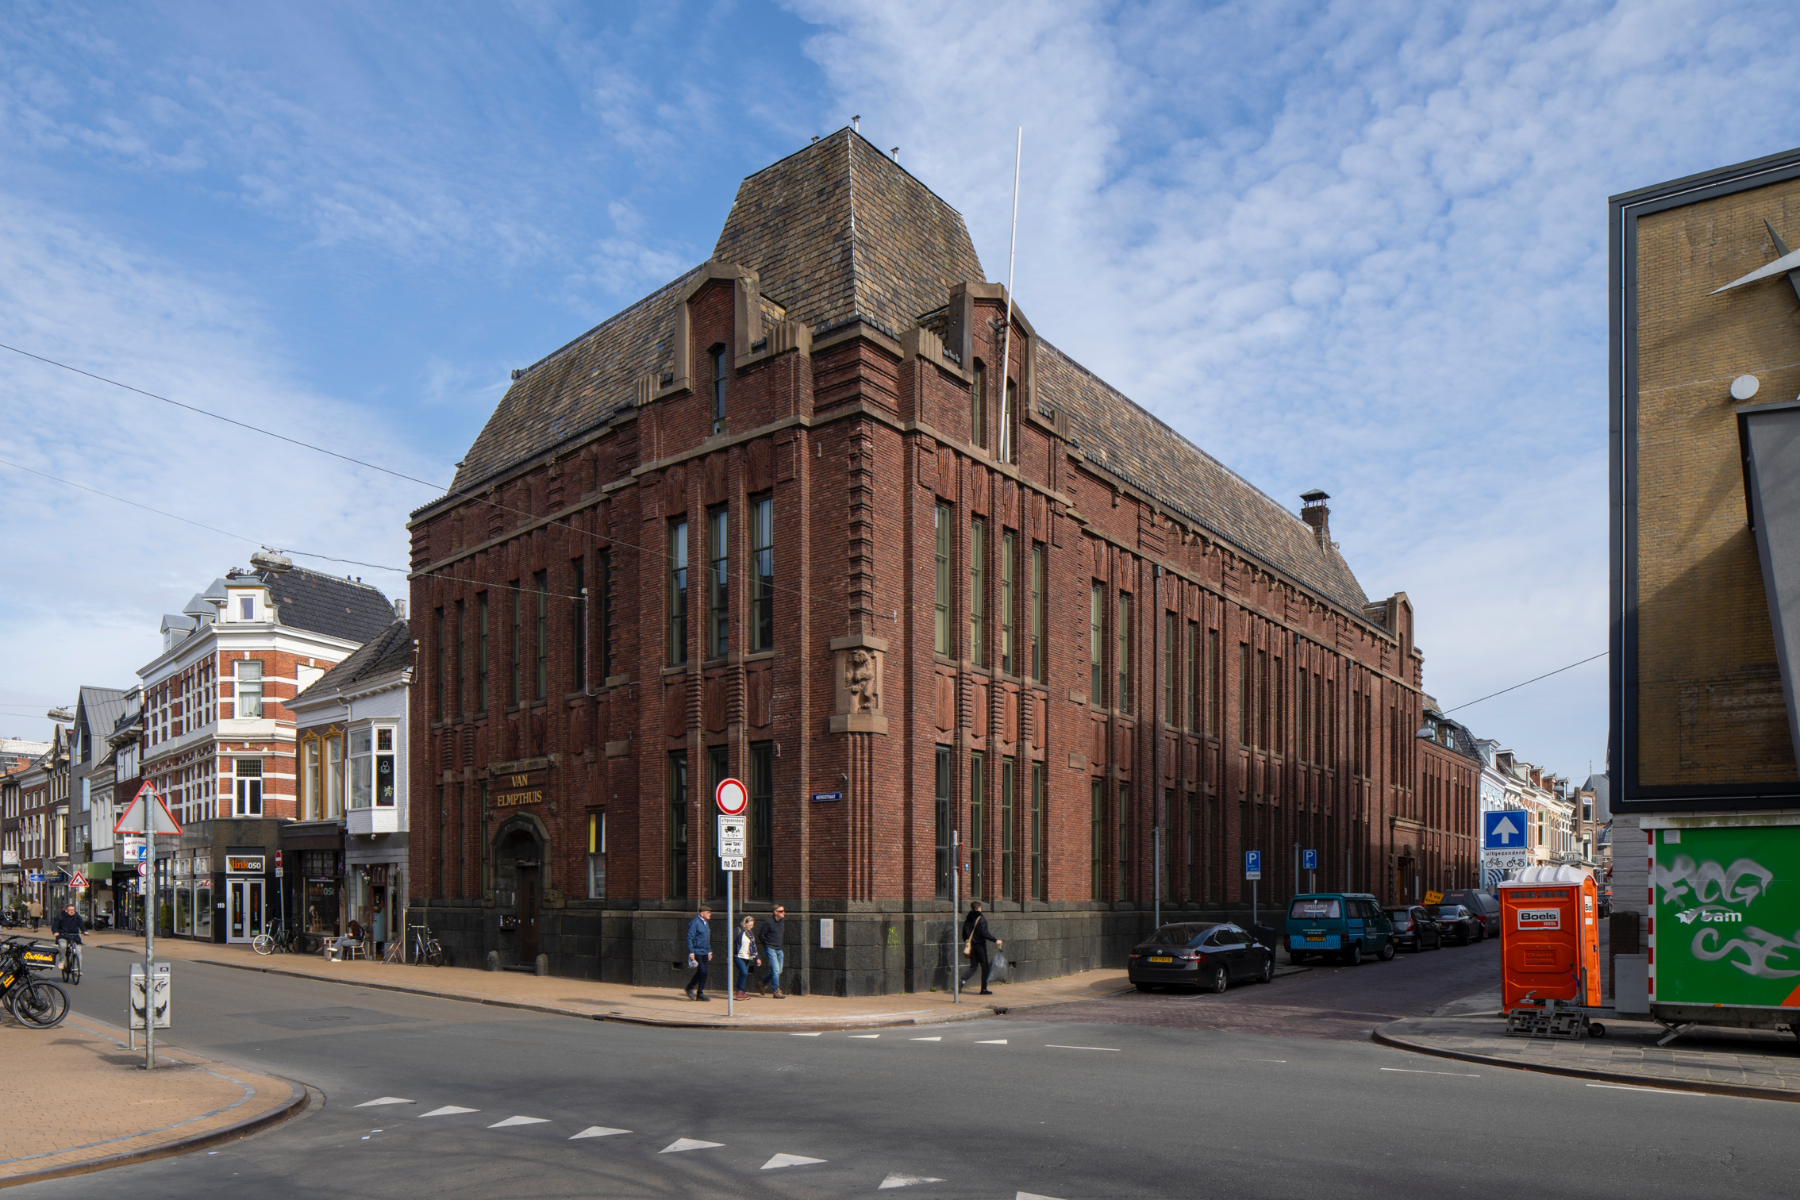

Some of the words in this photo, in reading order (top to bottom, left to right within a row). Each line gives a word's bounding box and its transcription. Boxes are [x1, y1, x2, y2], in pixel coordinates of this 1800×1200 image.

[512, 774, 528, 787] VAN
[497, 791, 542, 806] ELMPTHUIS
[232, 860, 261, 869] link050
[731, 860, 737, 868] 20
[1702, 911, 1742, 922] bam
